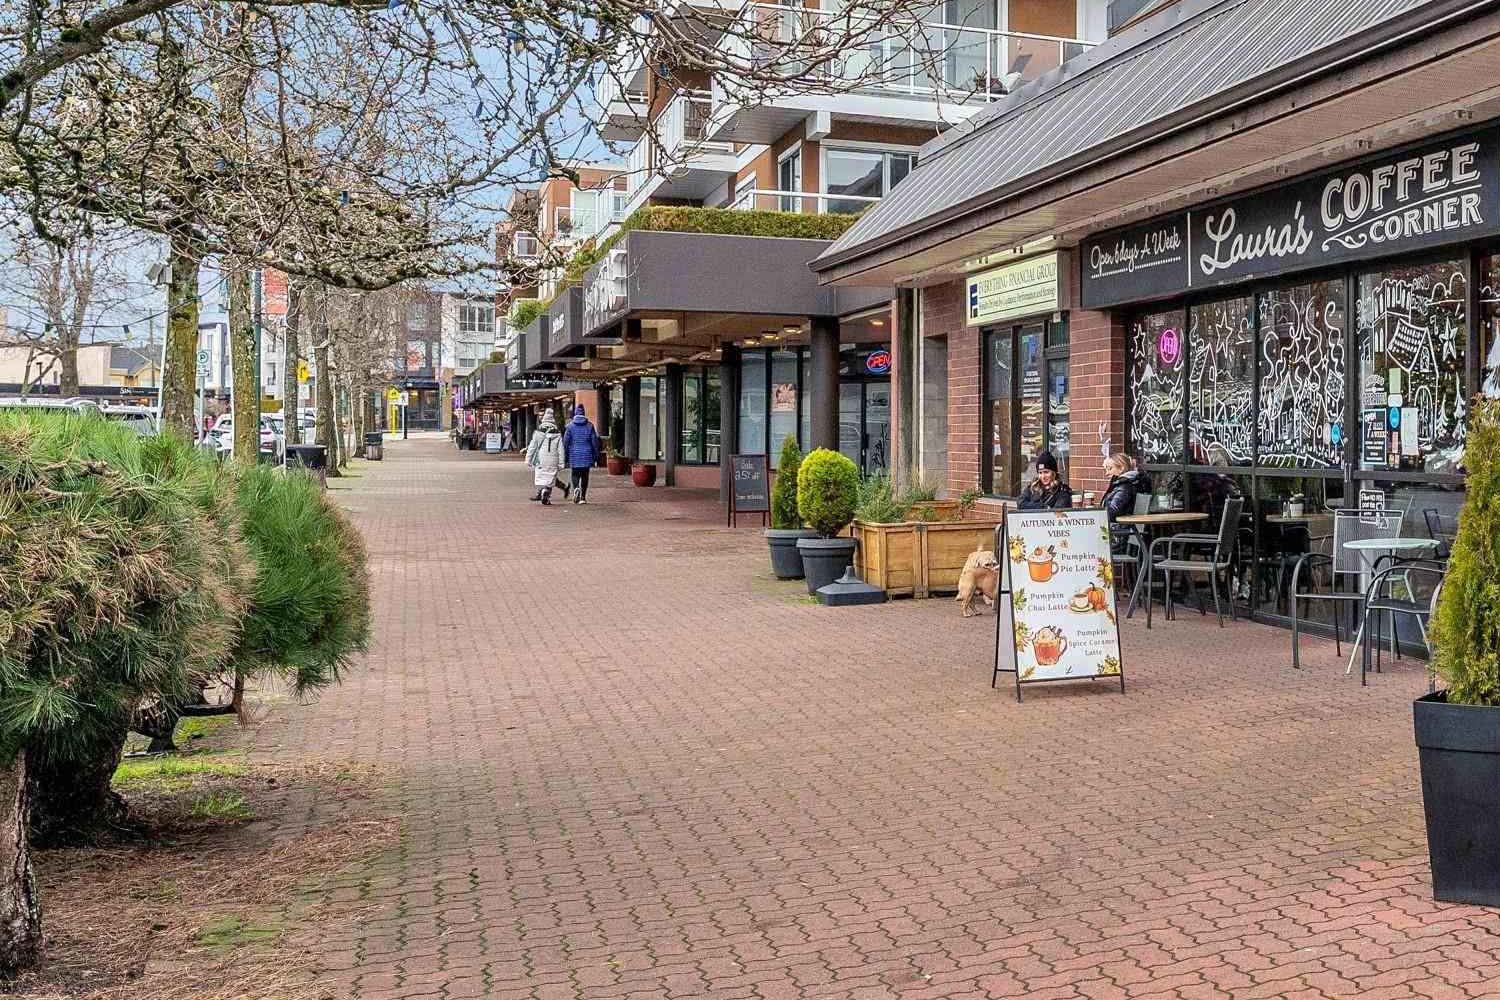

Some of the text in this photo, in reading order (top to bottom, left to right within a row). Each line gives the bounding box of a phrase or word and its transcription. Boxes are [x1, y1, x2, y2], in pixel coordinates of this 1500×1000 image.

[1320, 142, 1481, 232] COFFEE
[1369, 193, 1483, 243] CORNER
[1200, 200, 1313, 275] Laura's
[1091, 245, 1113, 276] Open
[1120, 240, 1139, 272] days
[1141, 233, 1151, 259] A
[1152, 226, 1181, 255] Week
[1037, 262, 1057, 280] GROUP
[869, 354, 891, 368] OPEN
[1021, 519, 1055, 528] AUTUMN
[1065, 518, 1096, 527] WINTER
[1048, 529, 1070, 538] VIBES
[1061, 552, 1096, 562] Pumpkin
[1060, 564, 1096, 573] Pie Latte
[1030, 592, 1064, 601] Pumpkin
[1048, 603, 1068, 611] Latte
[1077, 628, 1108, 637] Pumpkin
